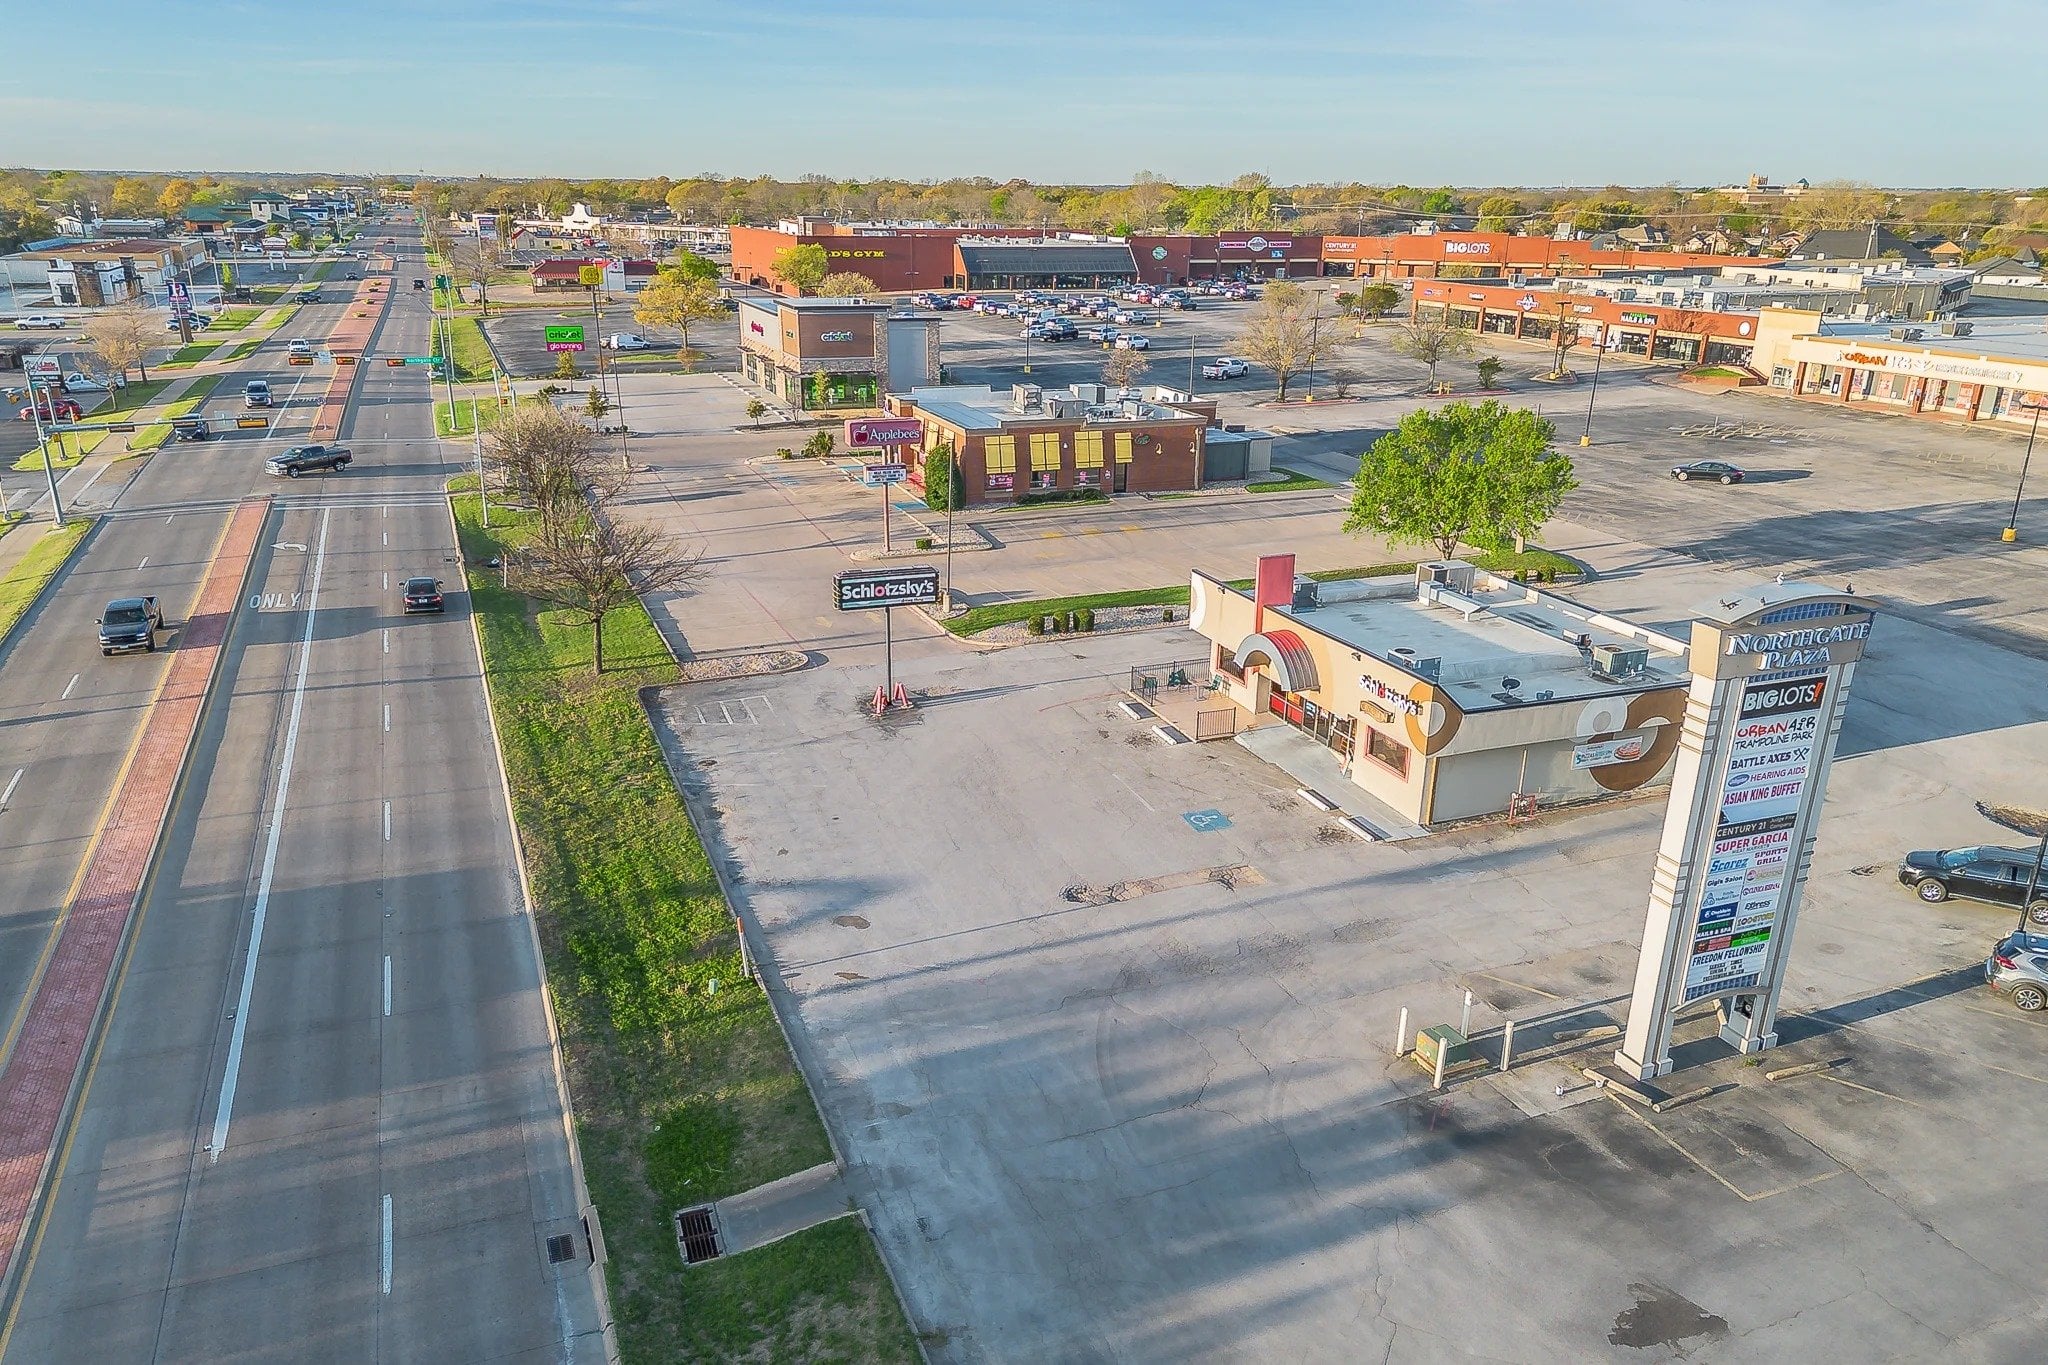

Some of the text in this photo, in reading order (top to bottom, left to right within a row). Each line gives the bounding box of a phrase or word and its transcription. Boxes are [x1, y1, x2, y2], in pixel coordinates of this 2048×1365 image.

[853, 250, 886, 258] GYM
[548, 330, 581, 339] cricket
[820, 330, 855, 342] cricket
[869, 428, 920, 442] Applebee's
[841, 580, 935, 600] Schlotzsky's
[249, 592, 302, 609] ONLY
[1725, 622, 1872, 656] NORTHGATE
[1757, 646, 1832, 671] PLAZA
[1737, 719, 1789, 738] URBAN
[1735, 730, 1815, 750] TRAMPOLINE PARK
[1730, 751, 1792, 770] BATTLE AXES
[1750, 769, 1786, 782] HEARING
[1787, 765, 1807, 776] AIDS
[1723, 782, 1802, 805] ASIAN KING BUFFET
[1716, 821, 1767, 837] CENTURY 21
[1715, 832, 1788, 854] SUPER GARCIA
[1754, 847, 1788, 858] SPORTS
[1756, 856, 1782, 866] GRILL
[1725, 876, 1743, 884] Salon
[1692, 952, 1724, 966] FREEDOM
[1724, 943, 1766, 959] FELLOWSHIP
